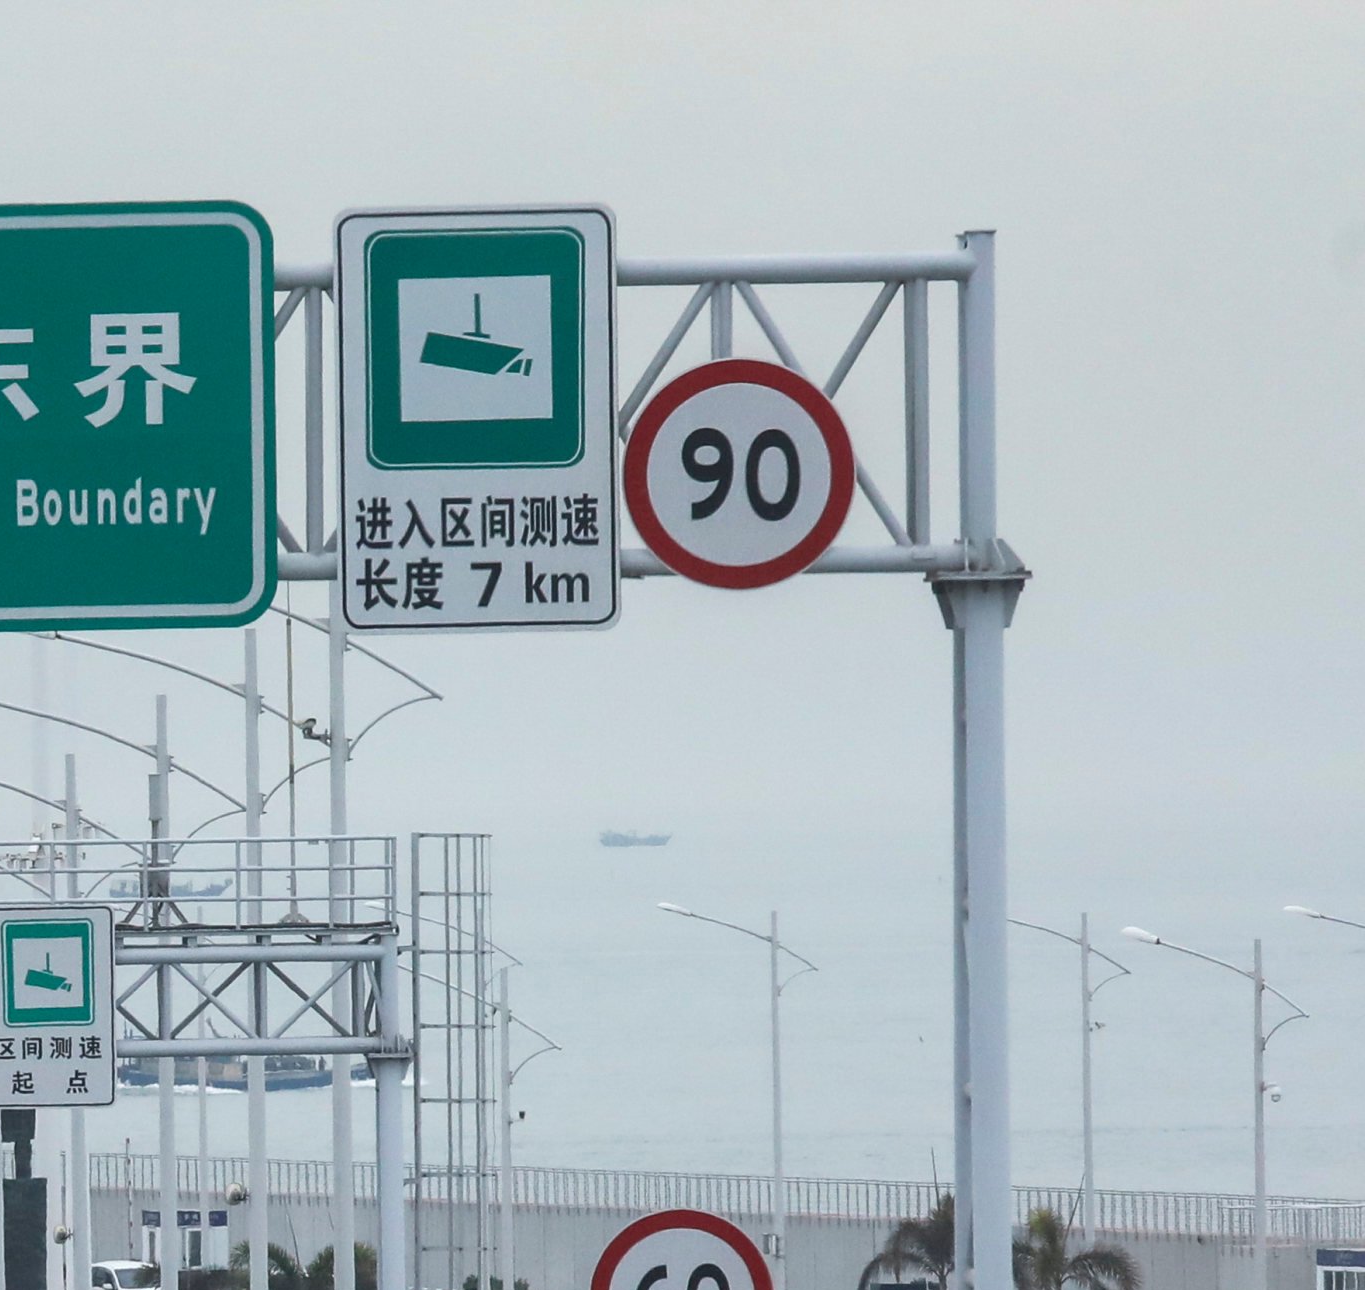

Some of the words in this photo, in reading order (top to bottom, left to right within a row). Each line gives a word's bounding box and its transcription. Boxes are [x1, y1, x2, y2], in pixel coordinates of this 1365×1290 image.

[680, 427, 802, 522] 90
[15, 477, 217, 536] Boundary
[355, 493, 600, 551] 进入区间测速
[356, 557, 445, 611] 长度
[469, 561, 503, 608] 7
[524, 560, 591, 604] km
[11, 1070, 89, 1096] 起点
